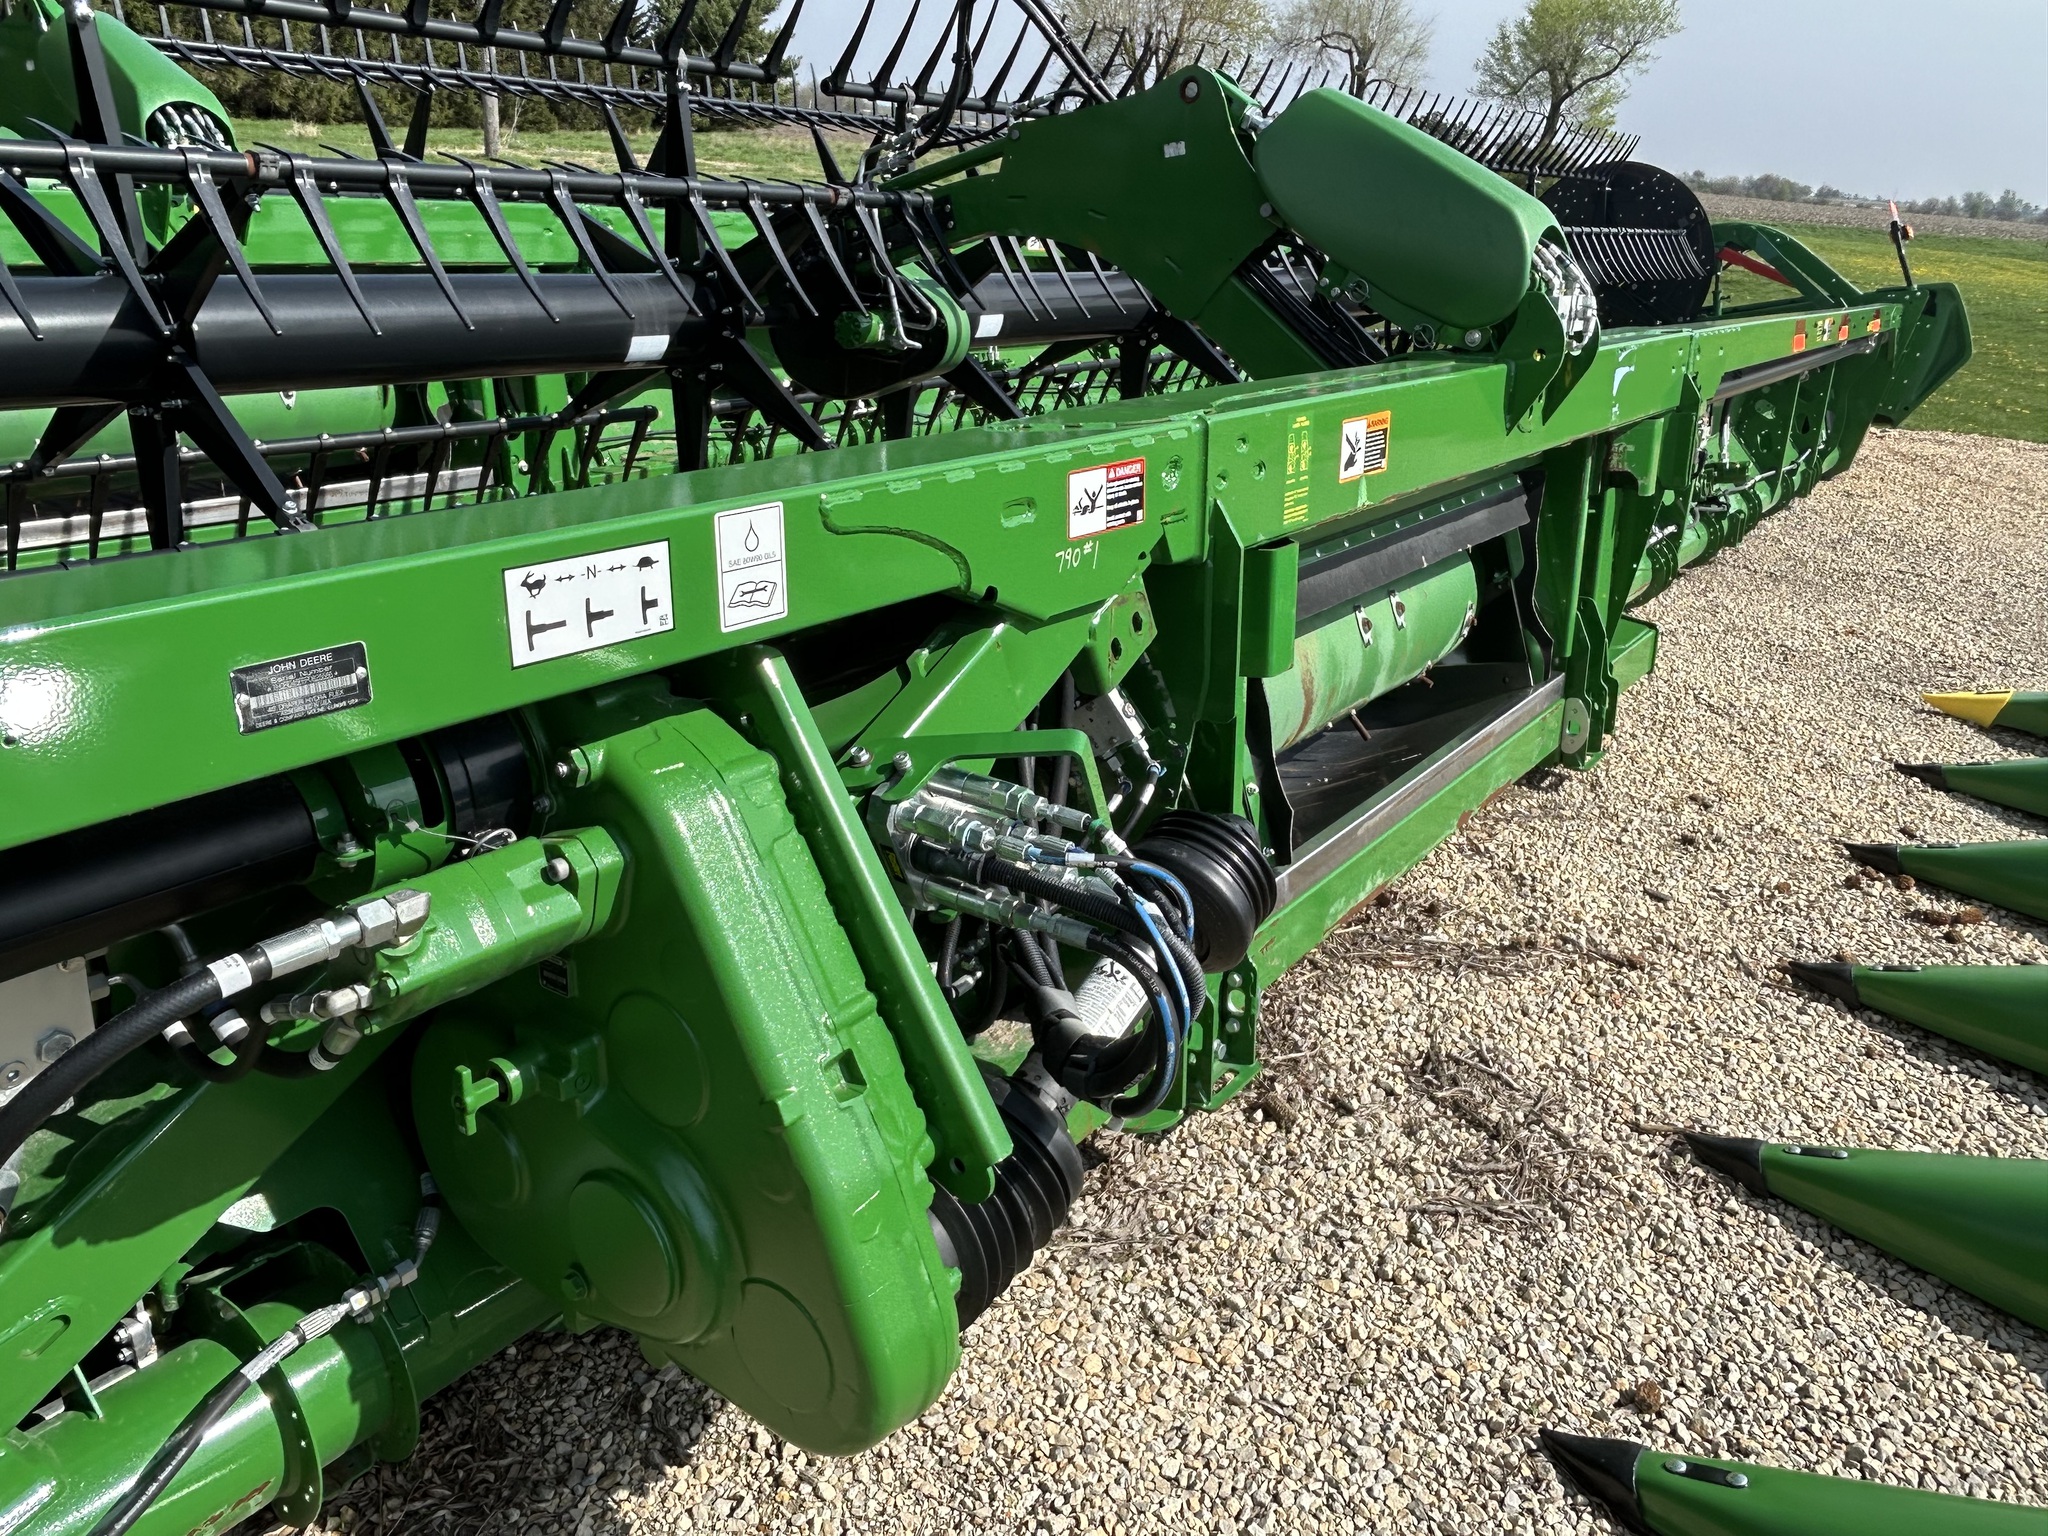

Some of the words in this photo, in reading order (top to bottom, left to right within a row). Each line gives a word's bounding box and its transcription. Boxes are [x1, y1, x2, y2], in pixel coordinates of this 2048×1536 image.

[1116, 463, 1141, 477] DANGER
[728, 559, 741, 568] SAE
[268, 661, 297, 675] JOHN
[300, 652, 333, 668] DEERE
[271, 673, 297, 684] Serial
[300, 665, 333, 676] Number
